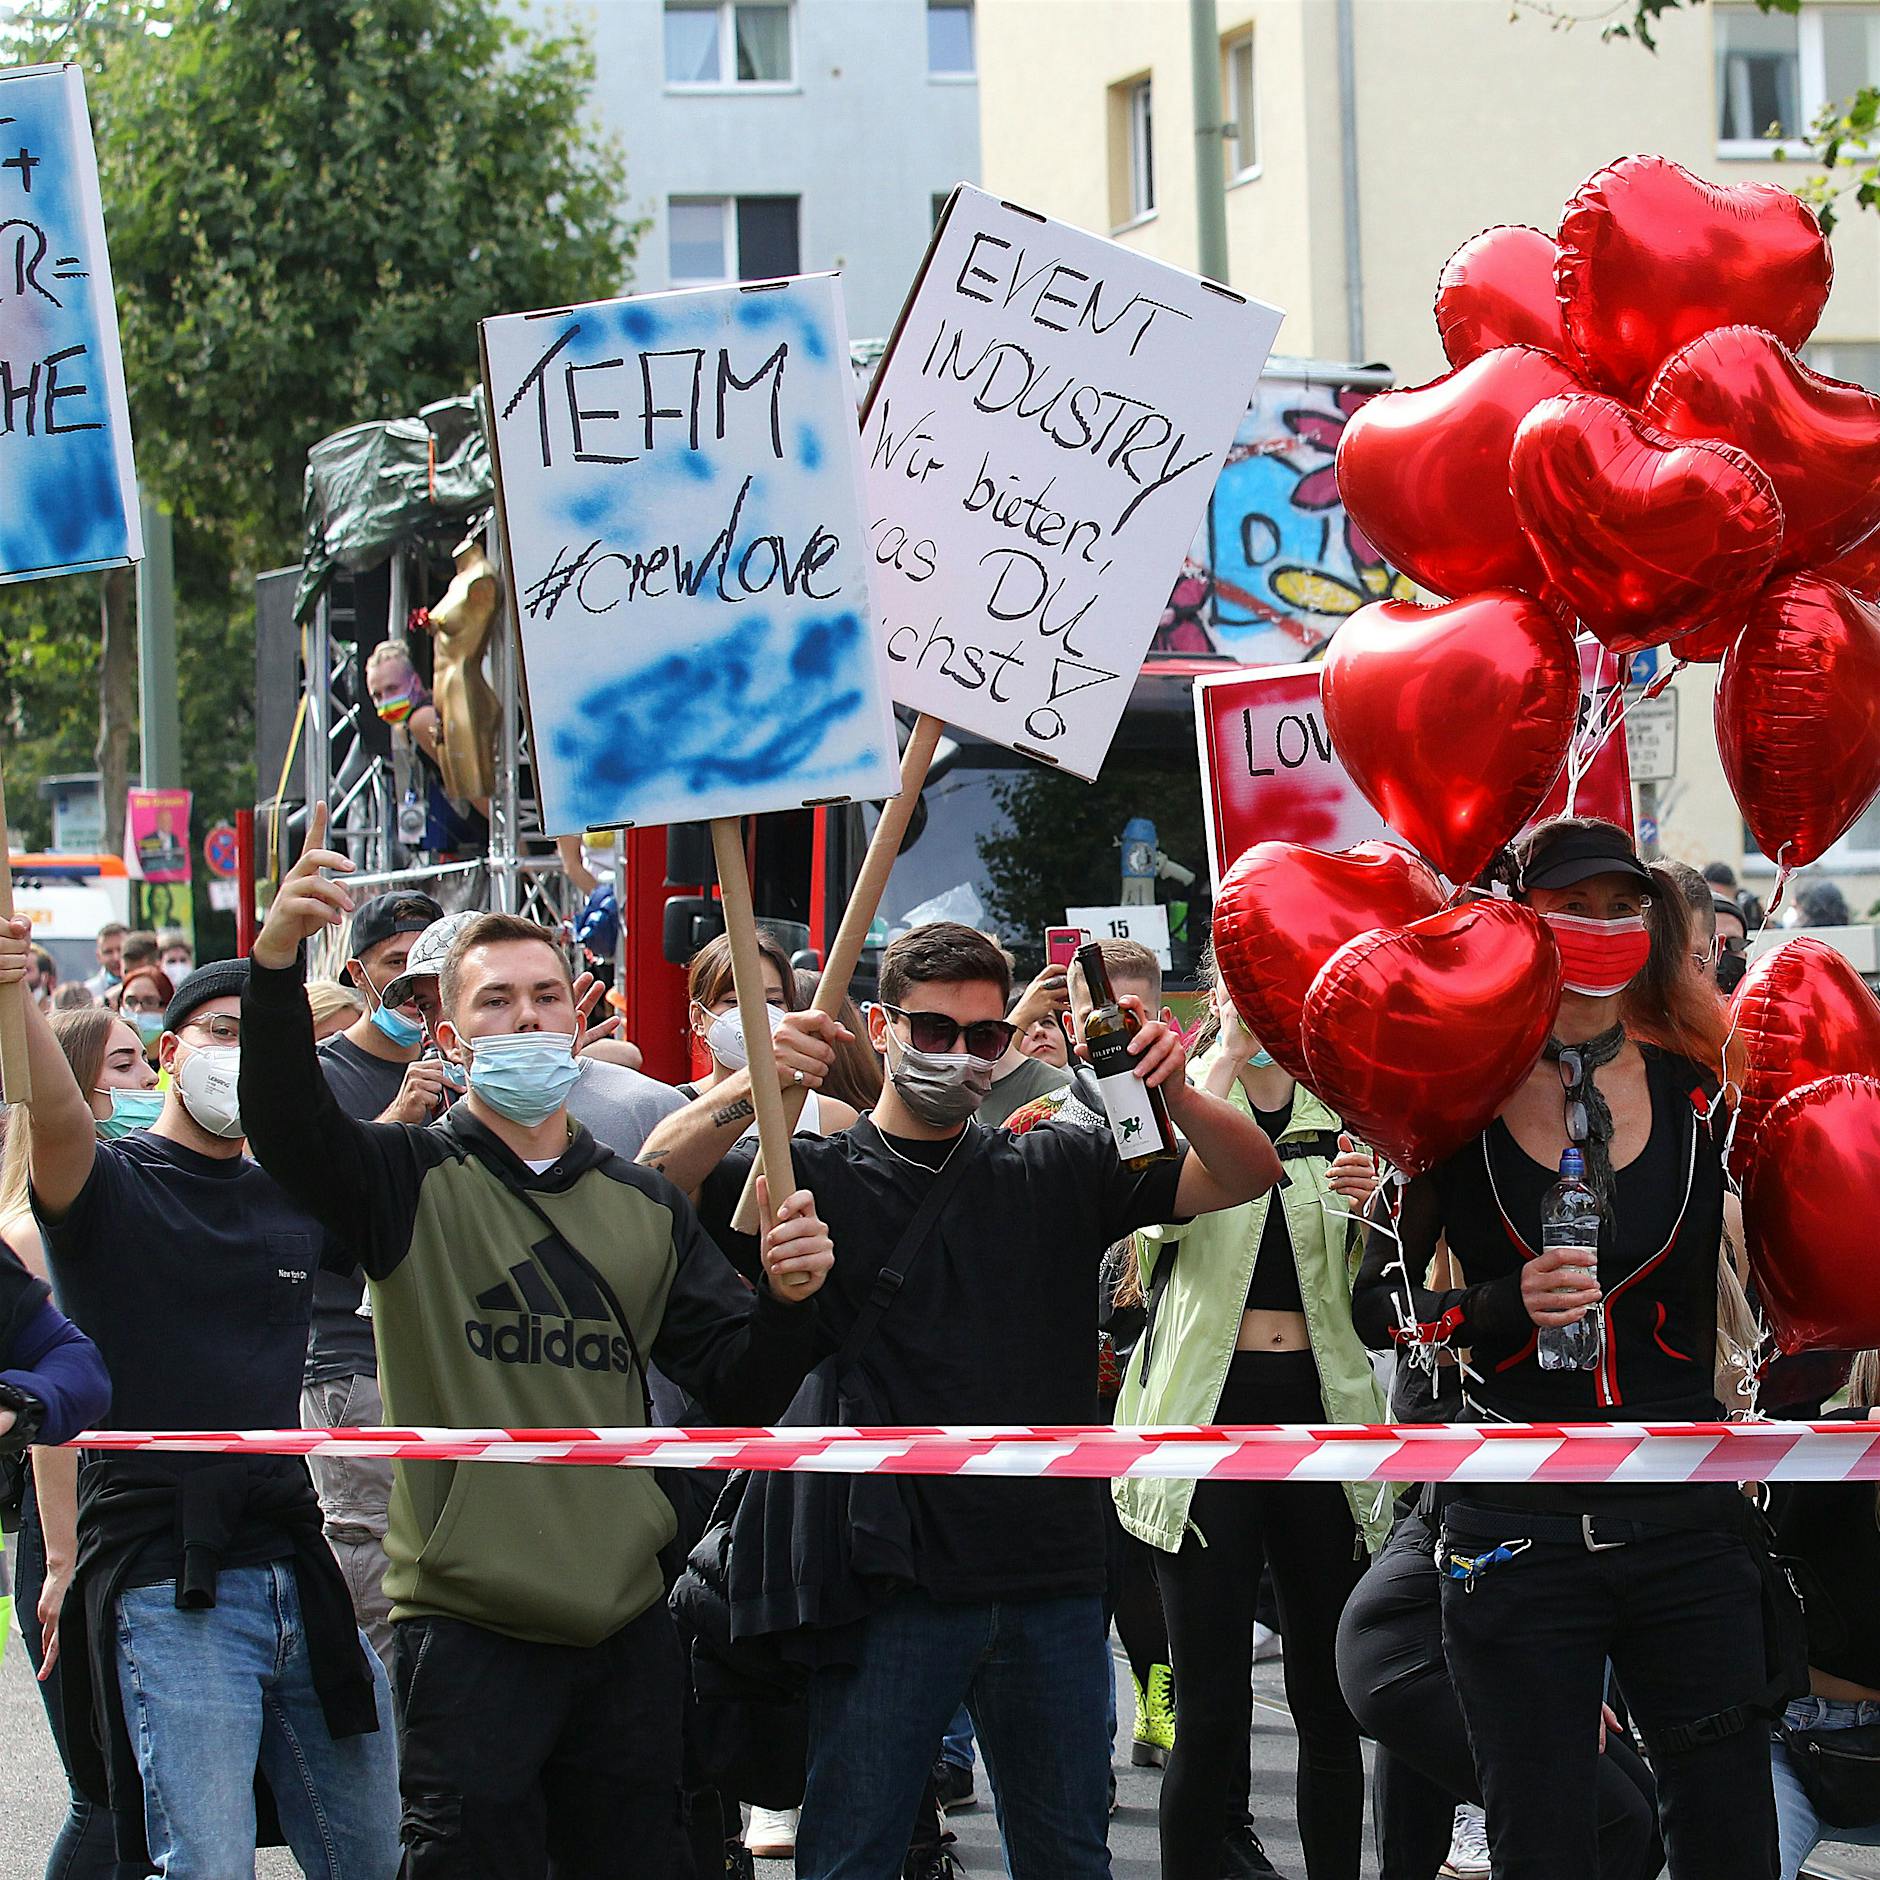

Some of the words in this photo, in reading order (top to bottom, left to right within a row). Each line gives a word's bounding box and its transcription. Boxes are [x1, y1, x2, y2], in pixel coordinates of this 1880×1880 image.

[0, 218, 90, 309] R=
[956, 231, 1194, 357] EVENT
[0, 344, 107, 437] HE
[501, 324, 788, 467] TEAM
[921, 318, 1214, 537] INDUSTRY
[870, 398, 945, 485] Wir
[870, 517, 937, 583] as
[1108, 920, 1130, 939] 15
[465, 1314, 629, 1375] adidas
